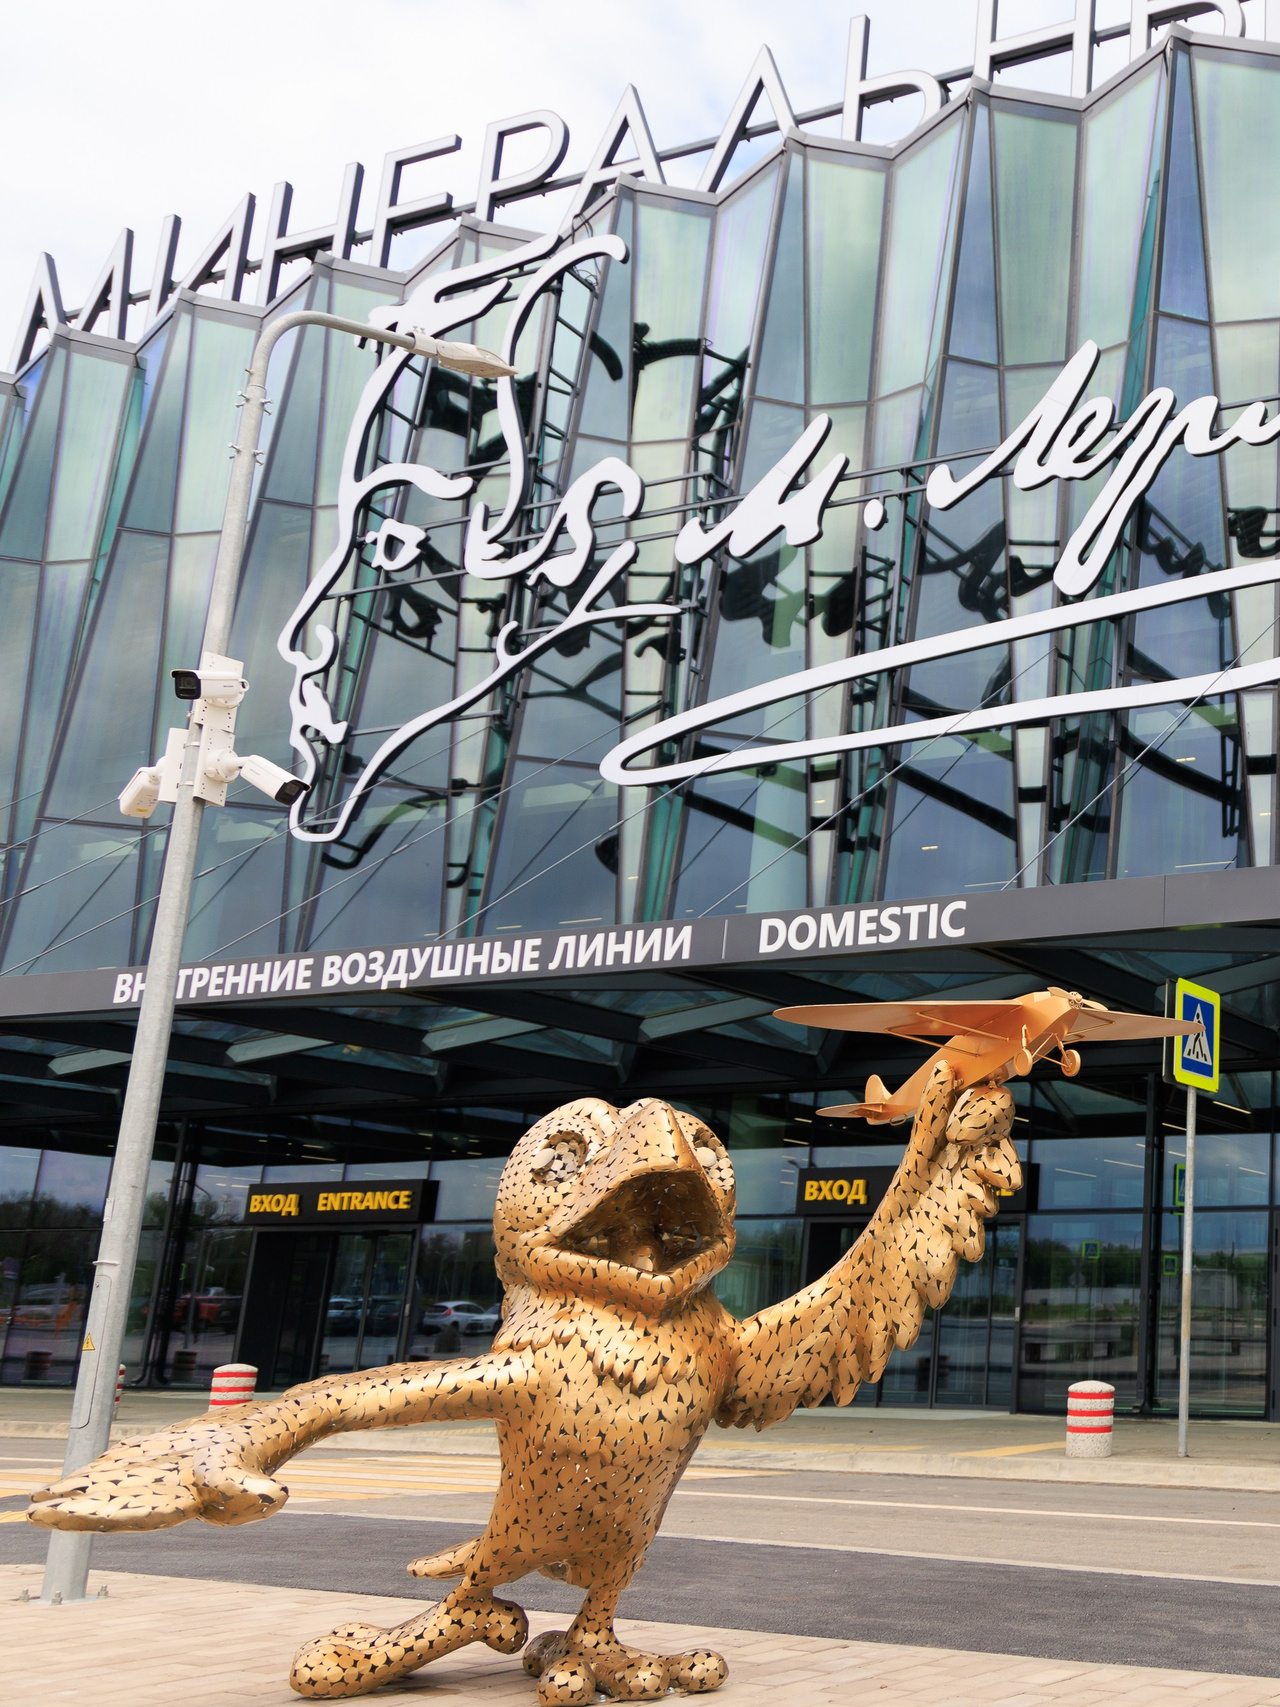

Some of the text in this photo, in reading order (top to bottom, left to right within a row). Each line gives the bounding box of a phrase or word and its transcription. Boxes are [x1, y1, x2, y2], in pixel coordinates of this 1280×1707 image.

[758, 900, 967, 954] DOMESTIC
[112, 925, 693, 1004] ВНТРЕННИЕ ВОЗДУШНЫЕ ЛИНИИ
[249, 1193, 300, 1217] ВХОД
[316, 1190, 413, 1212] ENTRANCE
[804, 1179, 868, 1205] ВХОД
